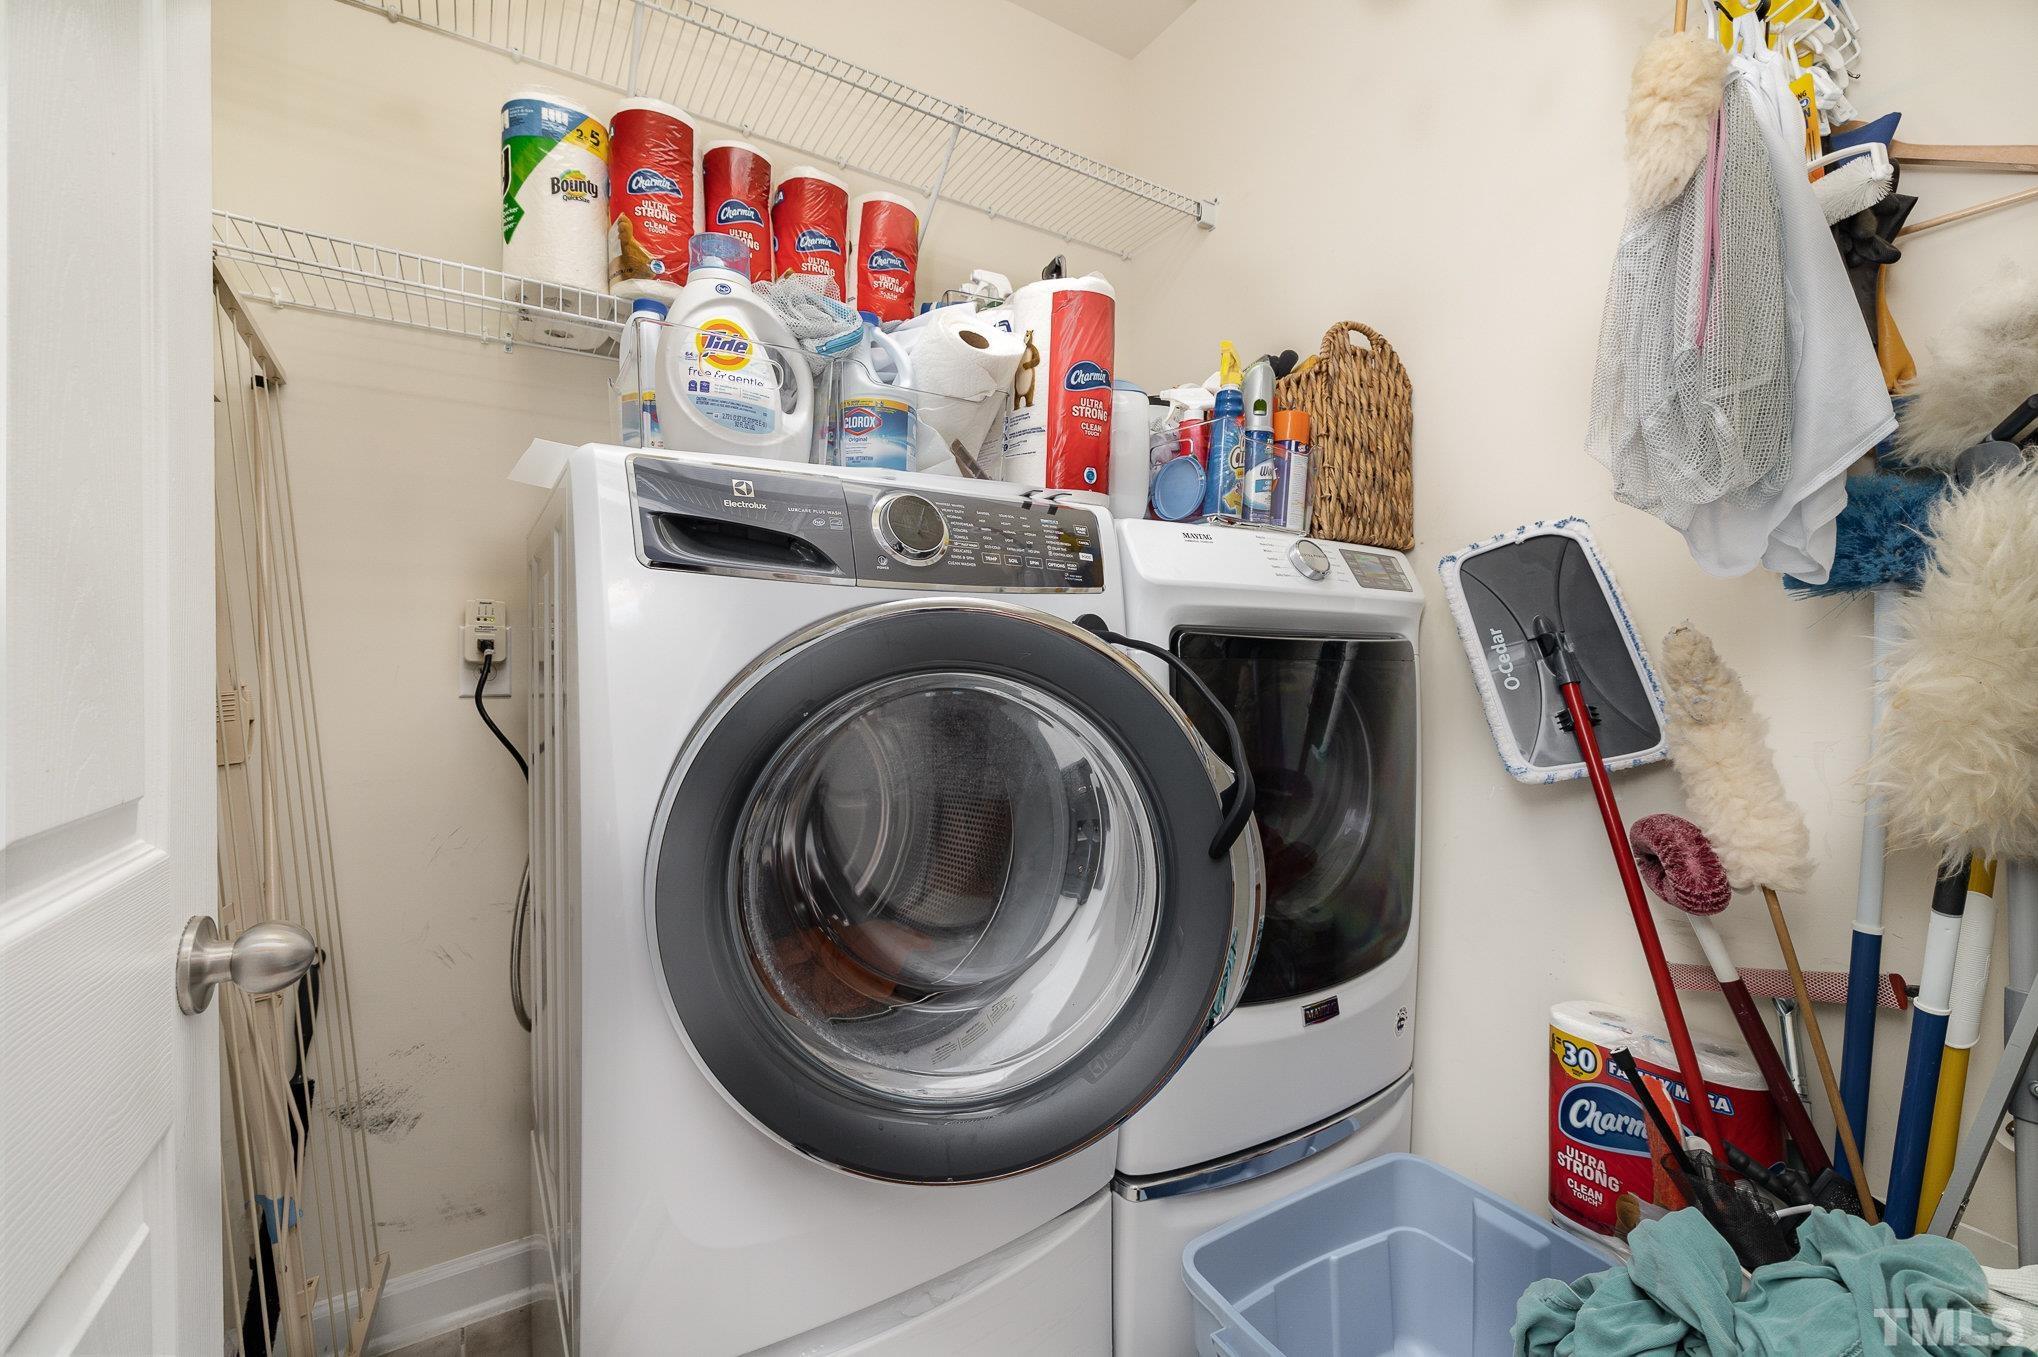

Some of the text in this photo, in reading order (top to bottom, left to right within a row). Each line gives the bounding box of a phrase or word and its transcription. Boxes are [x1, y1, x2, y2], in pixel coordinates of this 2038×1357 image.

[590, 130, 600, 147] 5
[550, 176, 598, 198] Bounty
[632, 176, 672, 190] Charmin
[642, 200, 669, 211] ULTRA
[634, 206, 677, 223] STRONG
[721, 206, 755, 220] Charmin
[644, 221, 668, 231] CLEAN
[729, 229, 753, 240] ULTRA
[800, 236, 832, 248] Charmin
[808, 256, 830, 268] ULTRA
[872, 256, 902, 268] Charmin
[801, 262, 836, 278] STRONG
[873, 280, 905, 294] STRONG
[880, 275, 900, 285] ULTRA
[703, 332, 749, 354] Tide
[1070, 370, 1106, 386] Charmin
[1080, 398, 1104, 410] ULTRA
[1072, 406, 1108, 422] STRONG
[844, 416, 876, 429] CLOROX
[1081, 422, 1102, 432] CLEAN
[724, 500, 768, 510] Electrolux
[1182, 532, 1213, 540] MAYTAG
[1562, 1040, 1597, 1074] 30
[1569, 1098, 1648, 1139] Charm
[1566, 1144, 1606, 1173] ULTRA
[1558, 1151, 1620, 1192] STRONG
[1567, 1178, 1603, 1202] CLEAN
[1572, 1189, 1598, 1207] TOUCH
